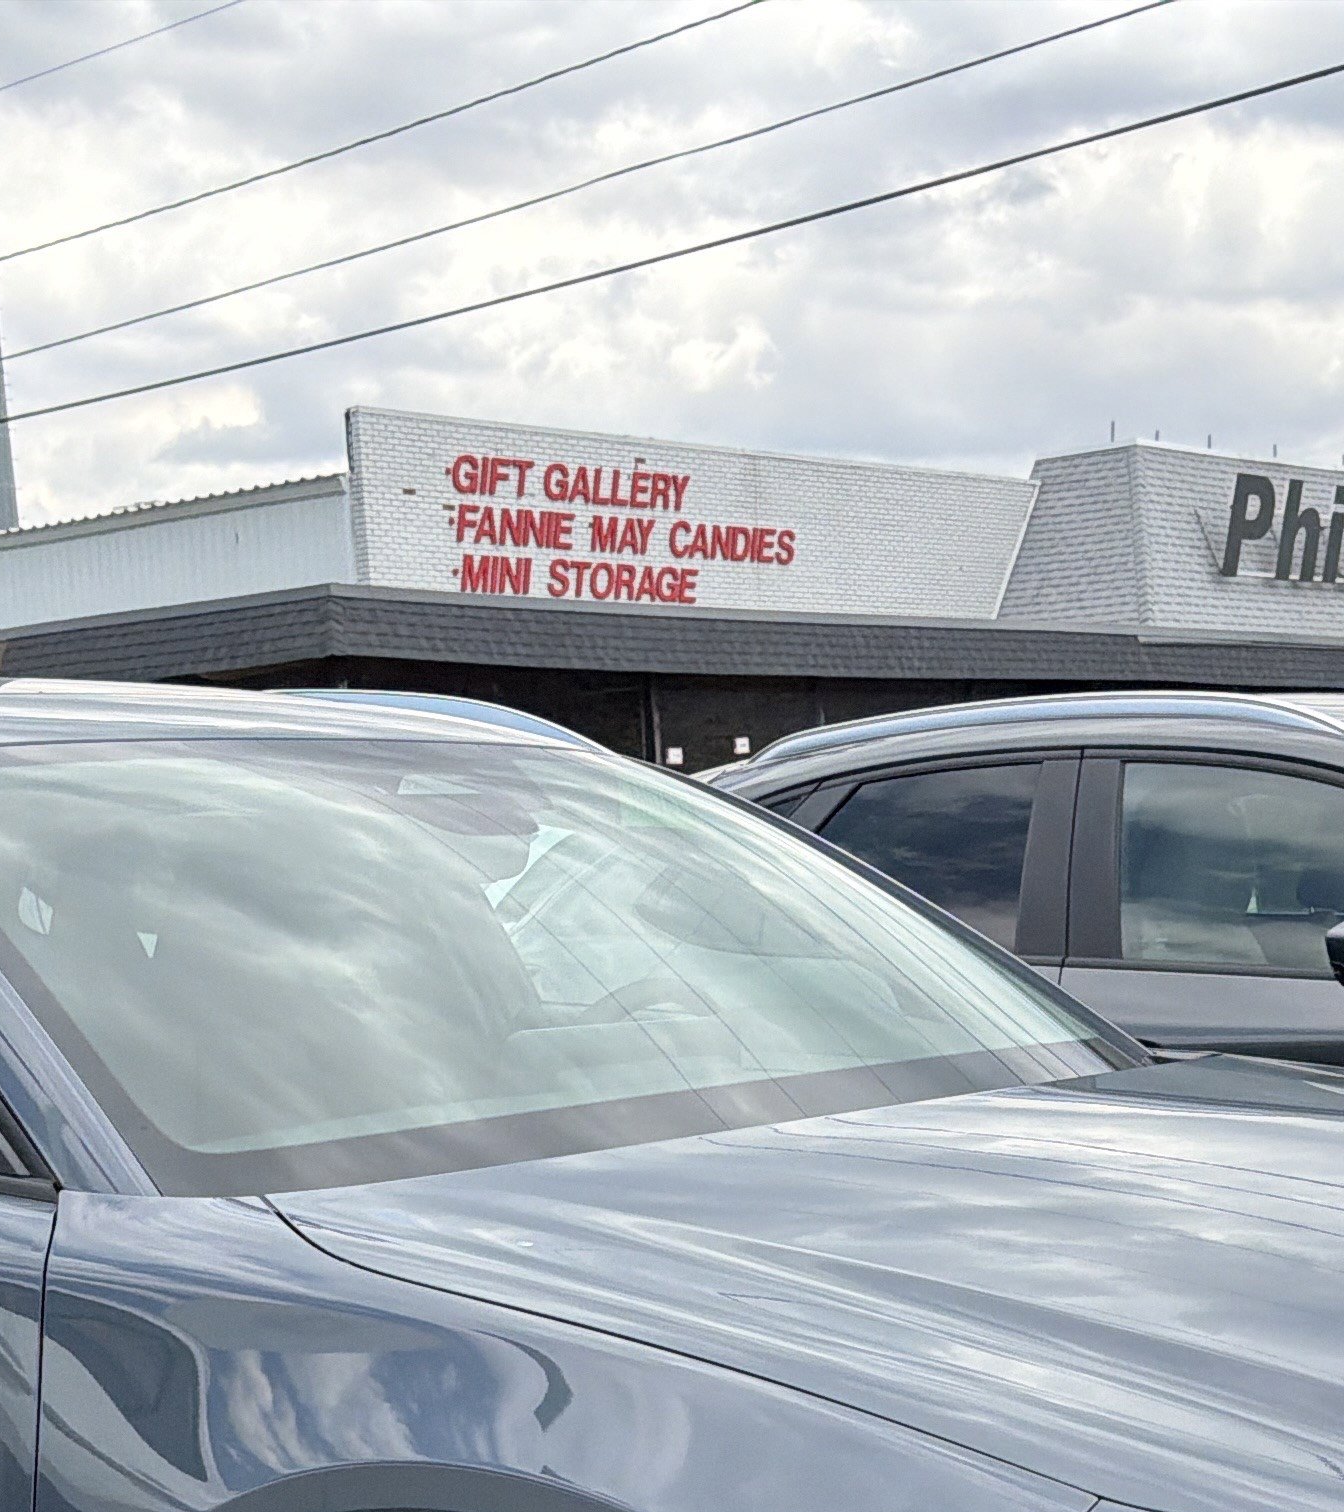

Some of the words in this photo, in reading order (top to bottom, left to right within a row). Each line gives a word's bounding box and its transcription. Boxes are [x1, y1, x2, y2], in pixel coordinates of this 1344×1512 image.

[452, 455, 535, 497] GIFT
[543, 463, 691, 511] GALLERY
[457, 504, 576, 550] FANNIE
[590, 514, 656, 555] MAY
[669, 520, 797, 565] CANDIES
[460, 554, 533, 595] MINI
[547, 559, 700, 604] STORAGE
